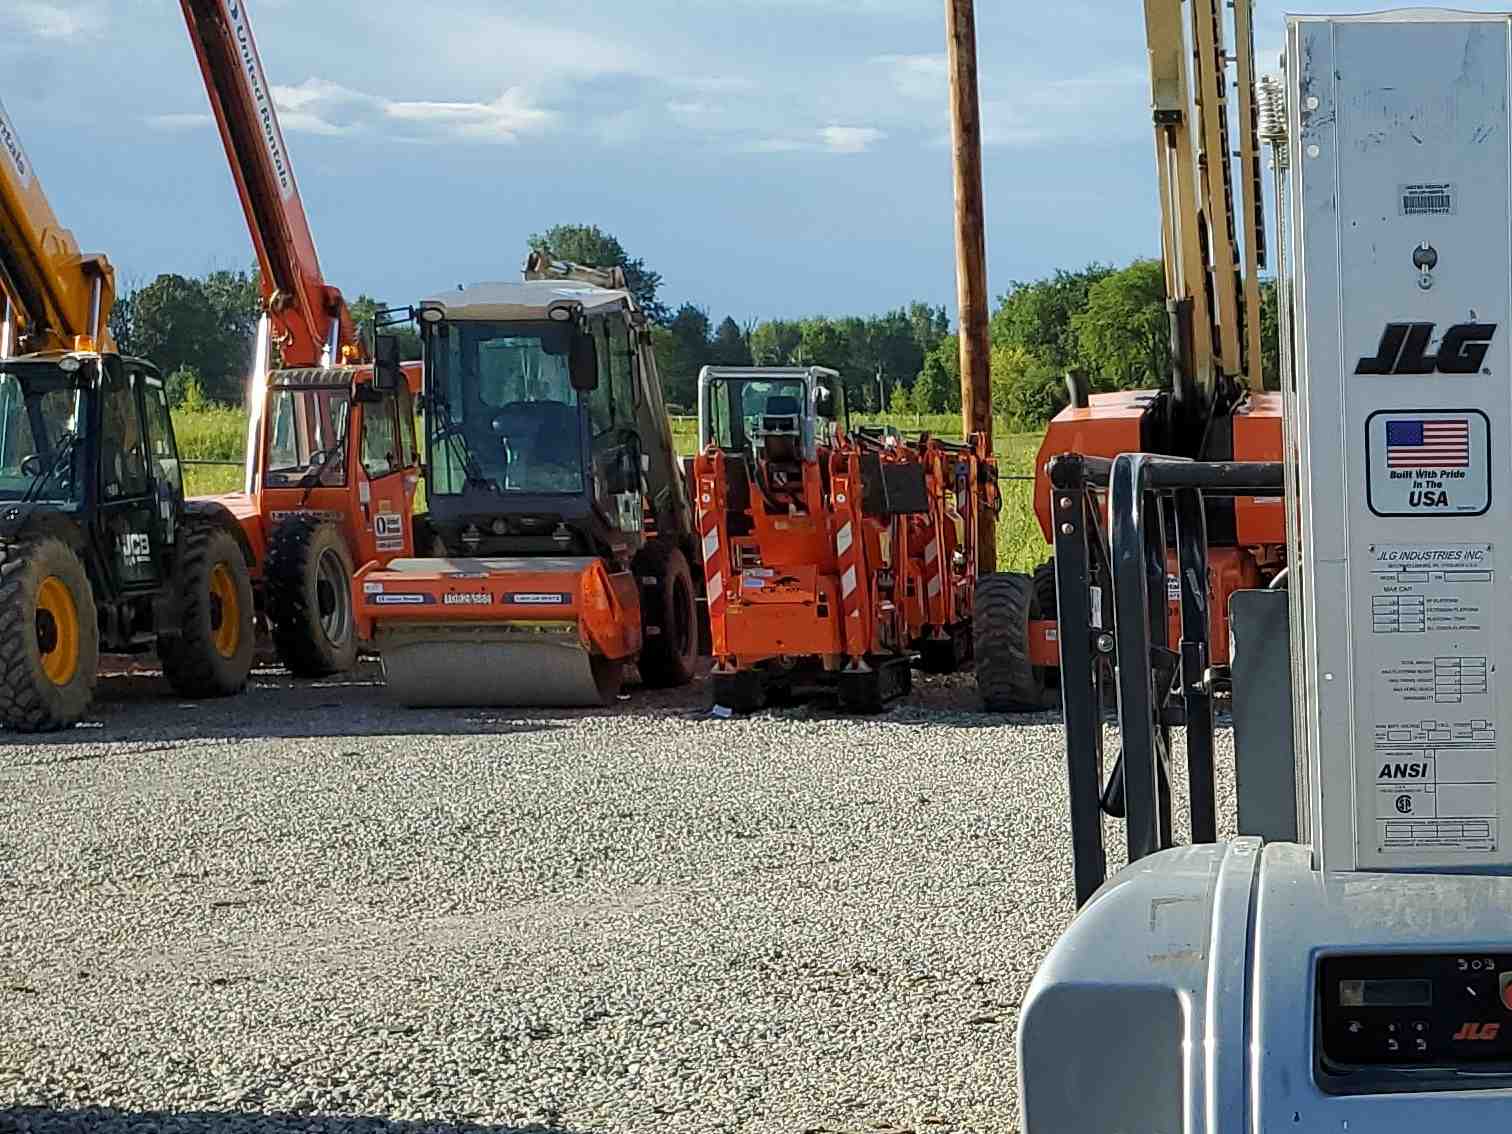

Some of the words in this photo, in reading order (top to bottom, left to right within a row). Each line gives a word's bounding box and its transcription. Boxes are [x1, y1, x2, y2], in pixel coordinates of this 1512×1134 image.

[236, 24, 264, 101] United
[260, 107, 288, 188] Rentals
[1354, 322, 1498, 375] JLG
[1390, 470, 1412, 479] Built
[1415, 468, 1438, 479] With
[1440, 470, 1466, 479] Pride
[1413, 480, 1423, 489] In
[1425, 480, 1443, 489] The
[1408, 490, 1449, 507] USA
[123, 533, 150, 555] JCB
[1376, 552, 1400, 561] JLG
[1400, 550, 1462, 561] INDUSTRIES
[1378, 762, 1428, 779] ANSI
[1453, 1022, 1501, 1040] JLG
